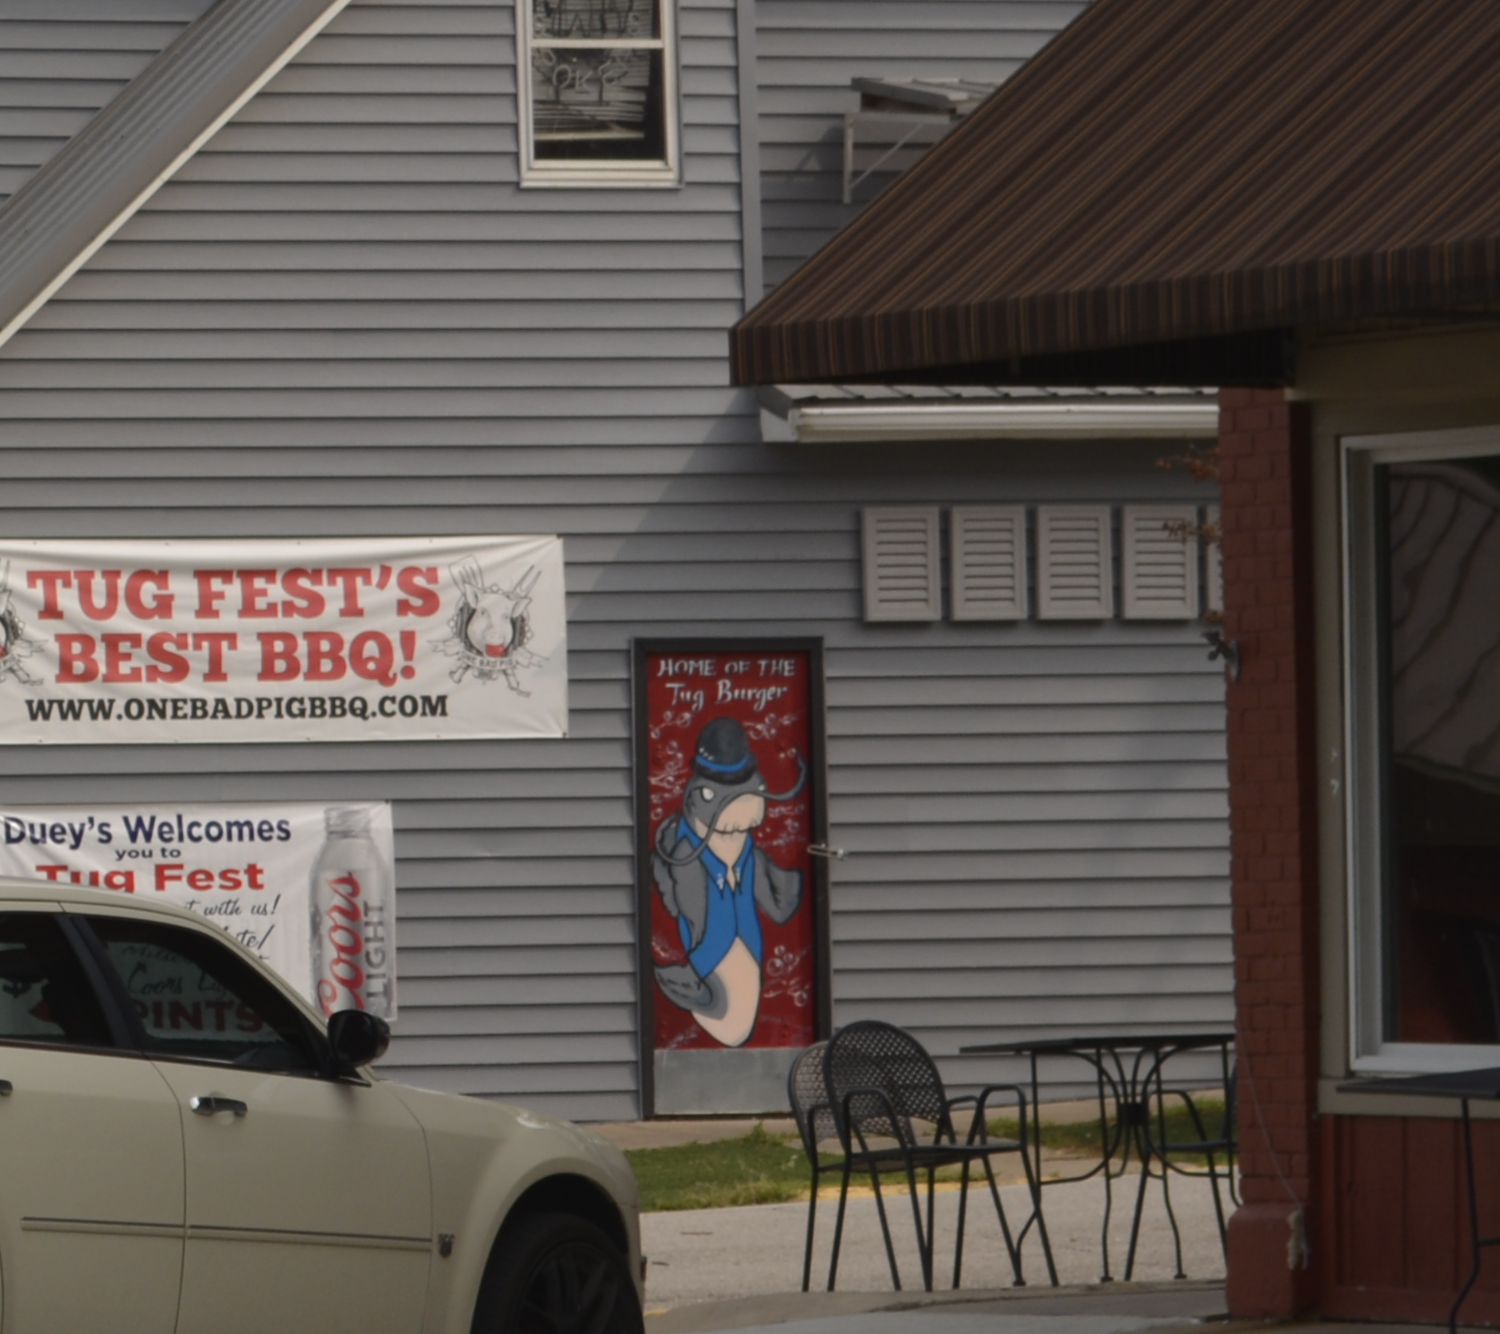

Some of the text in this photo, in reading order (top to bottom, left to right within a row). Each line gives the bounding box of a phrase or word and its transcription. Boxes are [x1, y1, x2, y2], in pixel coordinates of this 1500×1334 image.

[26, 564, 441, 621] TUG FEST'S
[54, 630, 417, 687] BEST BBQ!
[657, 658, 795, 677] HOME OF THE
[25, 694, 449, 722] WWW.ONEBADPIGBBQ.COM
[665, 678, 788, 712] Tug Burger
[4, 813, 292, 850] Duey's Welcomes
[115, 846, 182, 861] you to
[154, 862, 265, 892] Fest
[203, 898, 242, 917] with
[250, 894, 282, 917] us!
[317, 870, 365, 1019] Coors
[363, 900, 386, 1009] LIGHT
